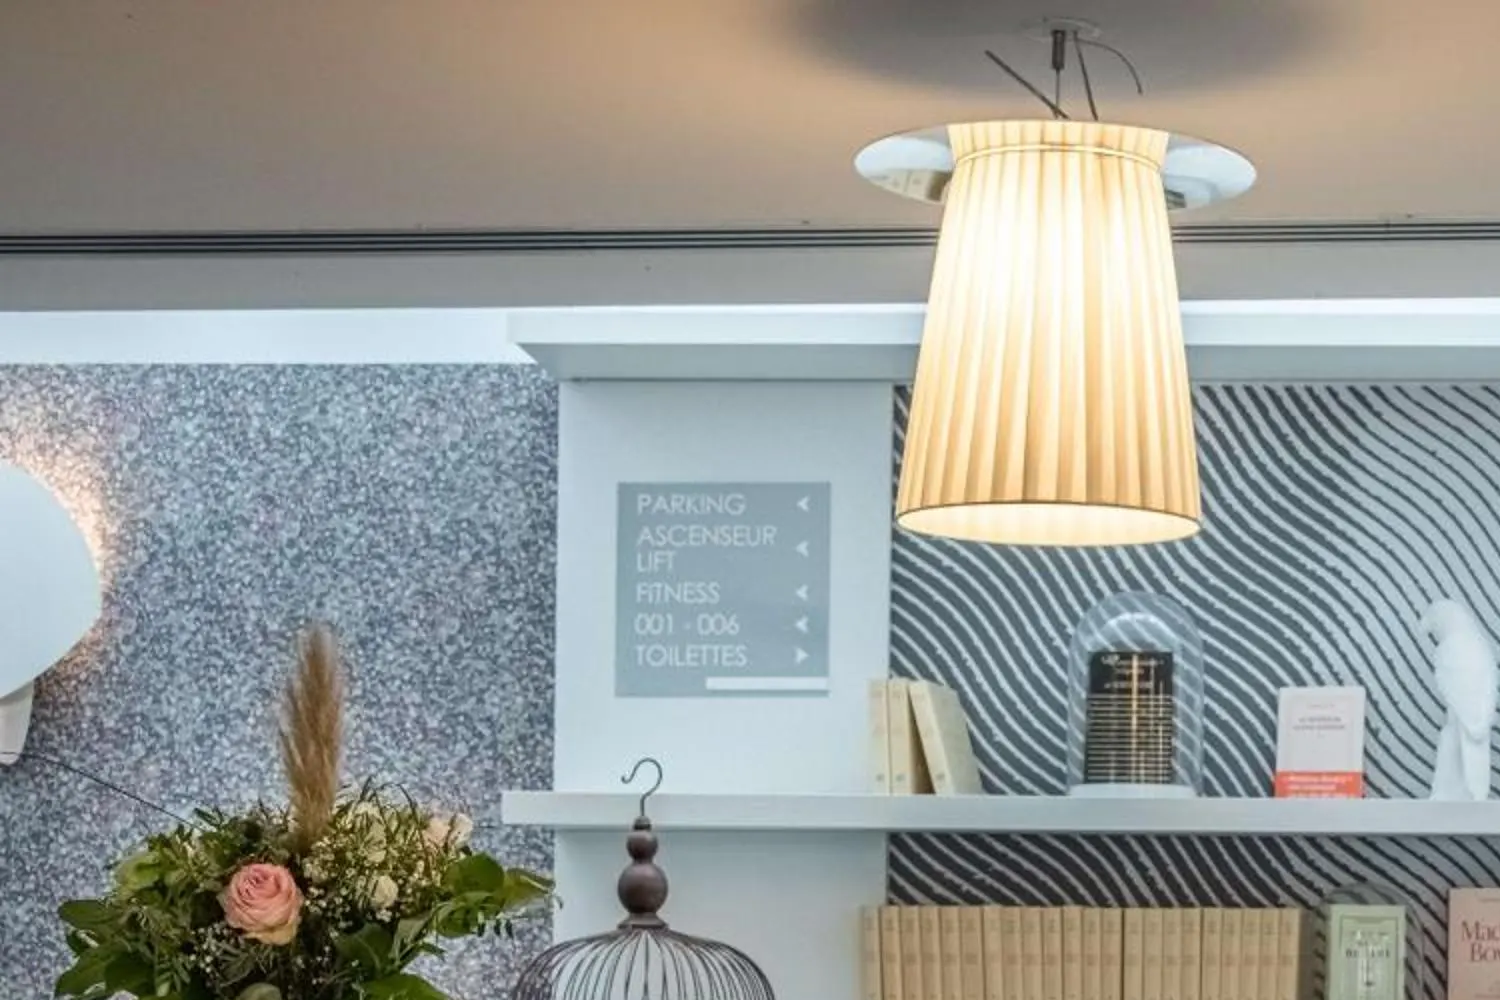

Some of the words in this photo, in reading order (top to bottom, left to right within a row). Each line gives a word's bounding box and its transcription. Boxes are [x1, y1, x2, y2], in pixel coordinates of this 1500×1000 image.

[636, 493, 746, 516] PARKING
[636, 524, 778, 547] ASCENSEUR
[636, 551, 676, 573] LIFT
[636, 581, 721, 604] FITNESS
[634, 613, 674, 635] 001
[697, 613, 741, 635] 006
[635, 644, 748, 667] TOILETTES
